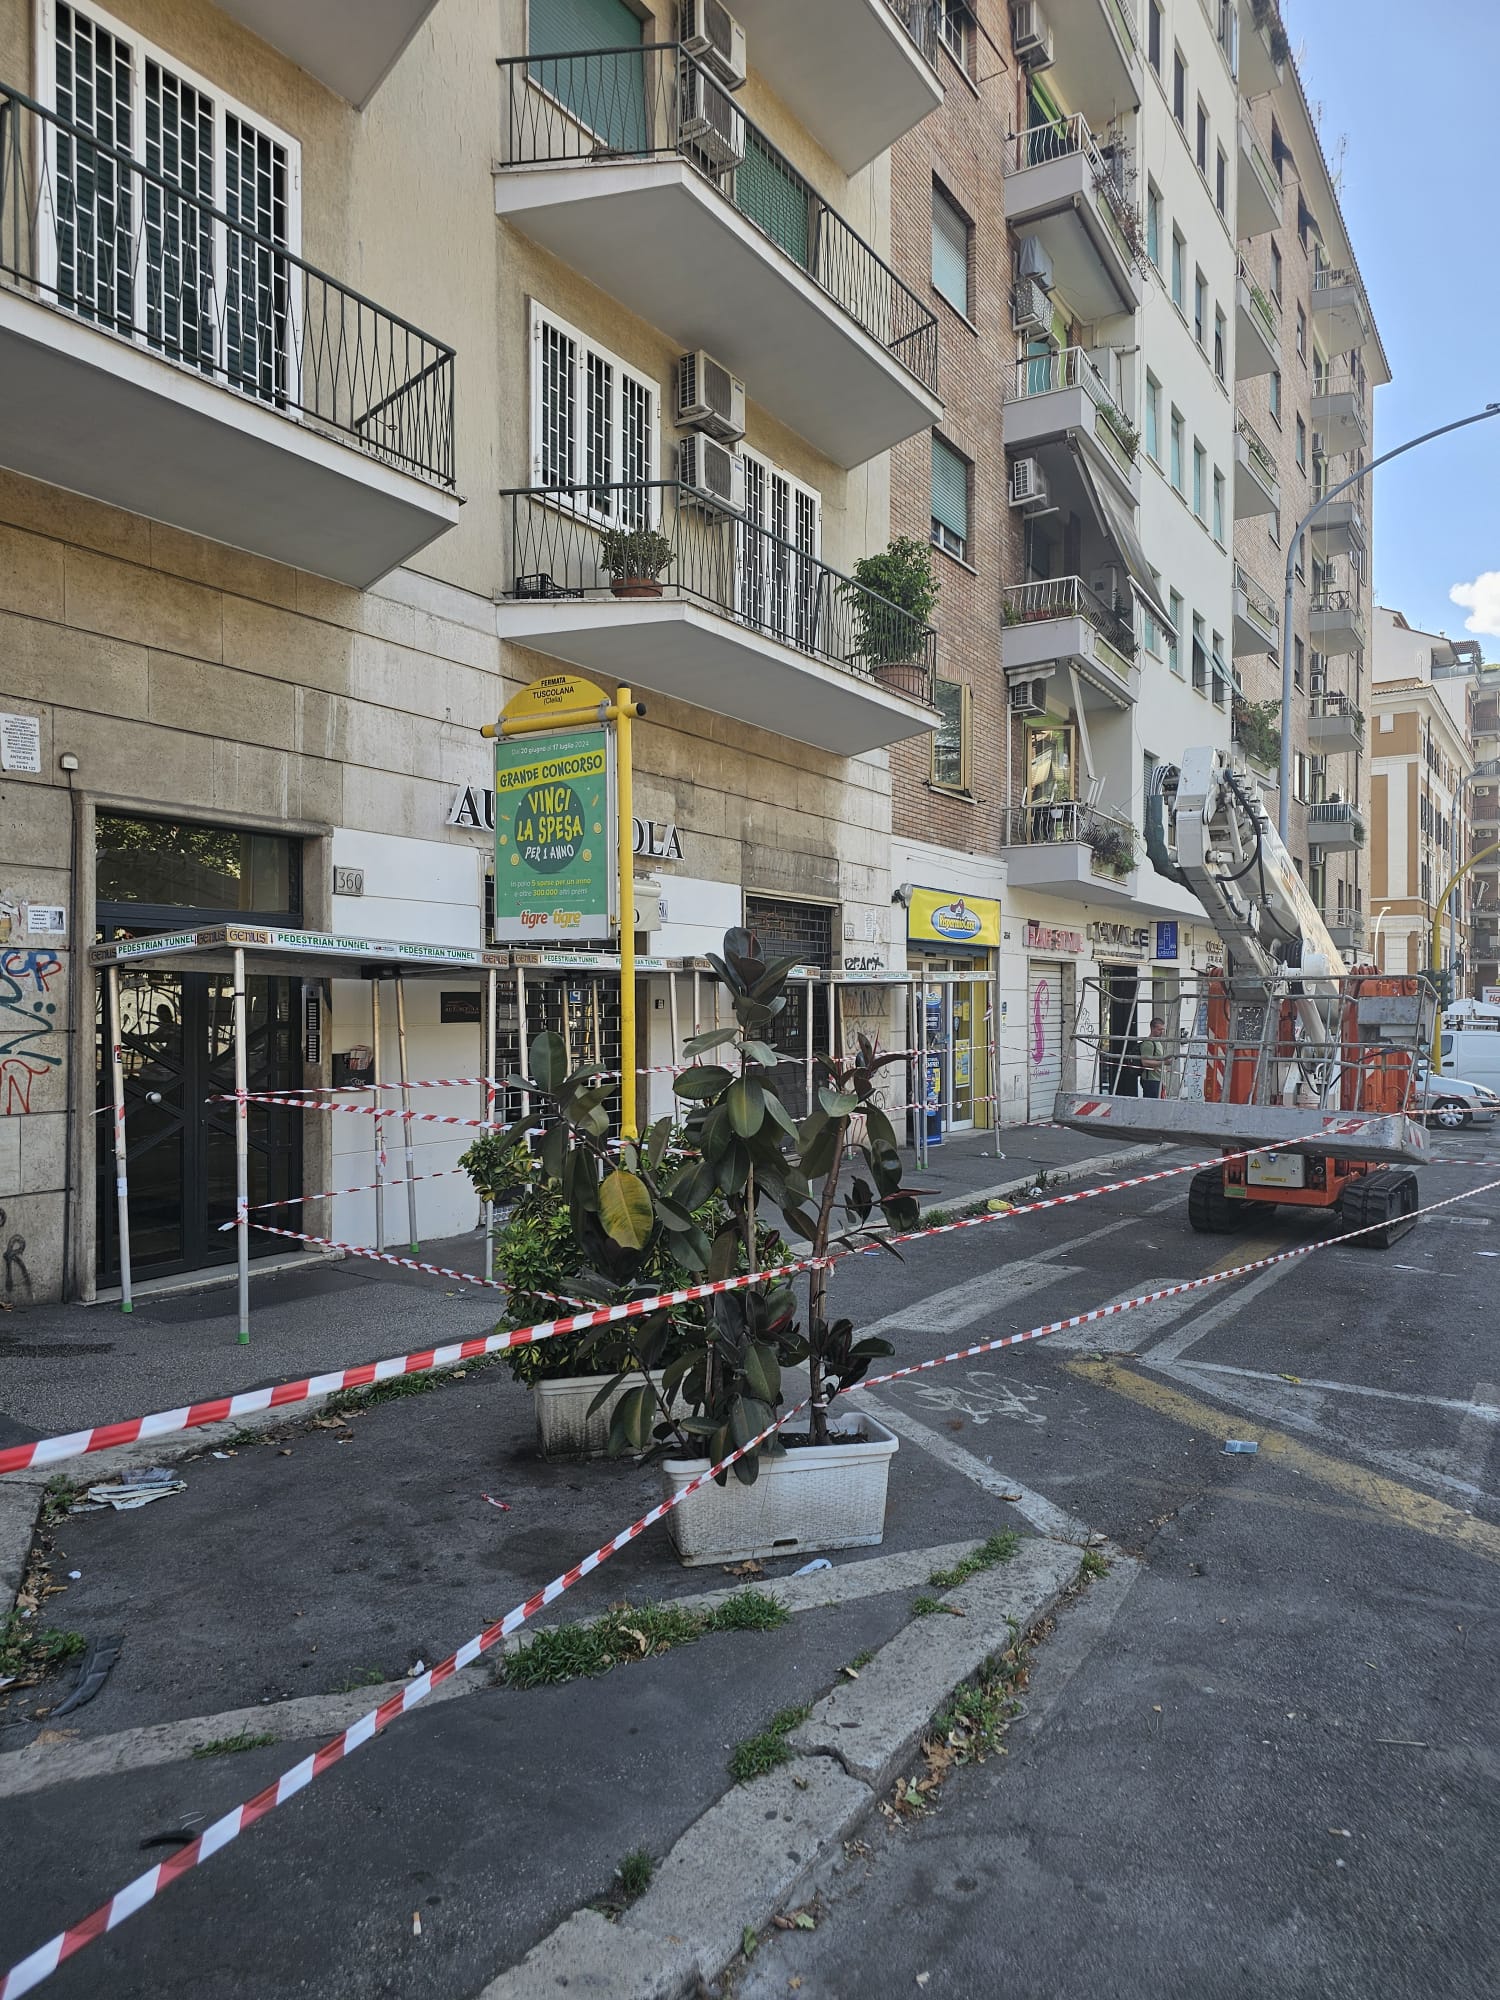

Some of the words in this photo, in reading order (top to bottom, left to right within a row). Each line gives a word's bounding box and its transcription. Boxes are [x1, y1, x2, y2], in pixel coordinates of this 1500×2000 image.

[541, 677, 566, 686] FERMATA
[533, 686, 574, 699] TUSCOLANA
[500, 768, 538, 788] GRANDE
[542, 754, 603, 779] CONCORSO
[527, 786, 572, 815] VINCI
[517, 818, 534, 842] LA
[538, 814, 583, 844] SPESA
[525, 846, 541, 862] PER
[543, 847, 548, 860] 1
[550, 844, 575, 860] ANNO
[338, 871, 362, 890] 360
[521, 910, 548, 929] tigre
[552, 909, 582, 929] tigre
[118, 939, 163, 954] PEDESTRIAN
[164, 935, 194, 947] TUNNEL
[278, 934, 334, 946] PEDESTRIAN
[336, 939, 370, 950] TUNNEL
[399, 945, 445, 957] PEDESTRIAN
[447, 949, 475, 960] TUNNEL
[544, 955, 577, 963] PEDESTRIAN
[578, 956, 599, 964] TUNNEL
